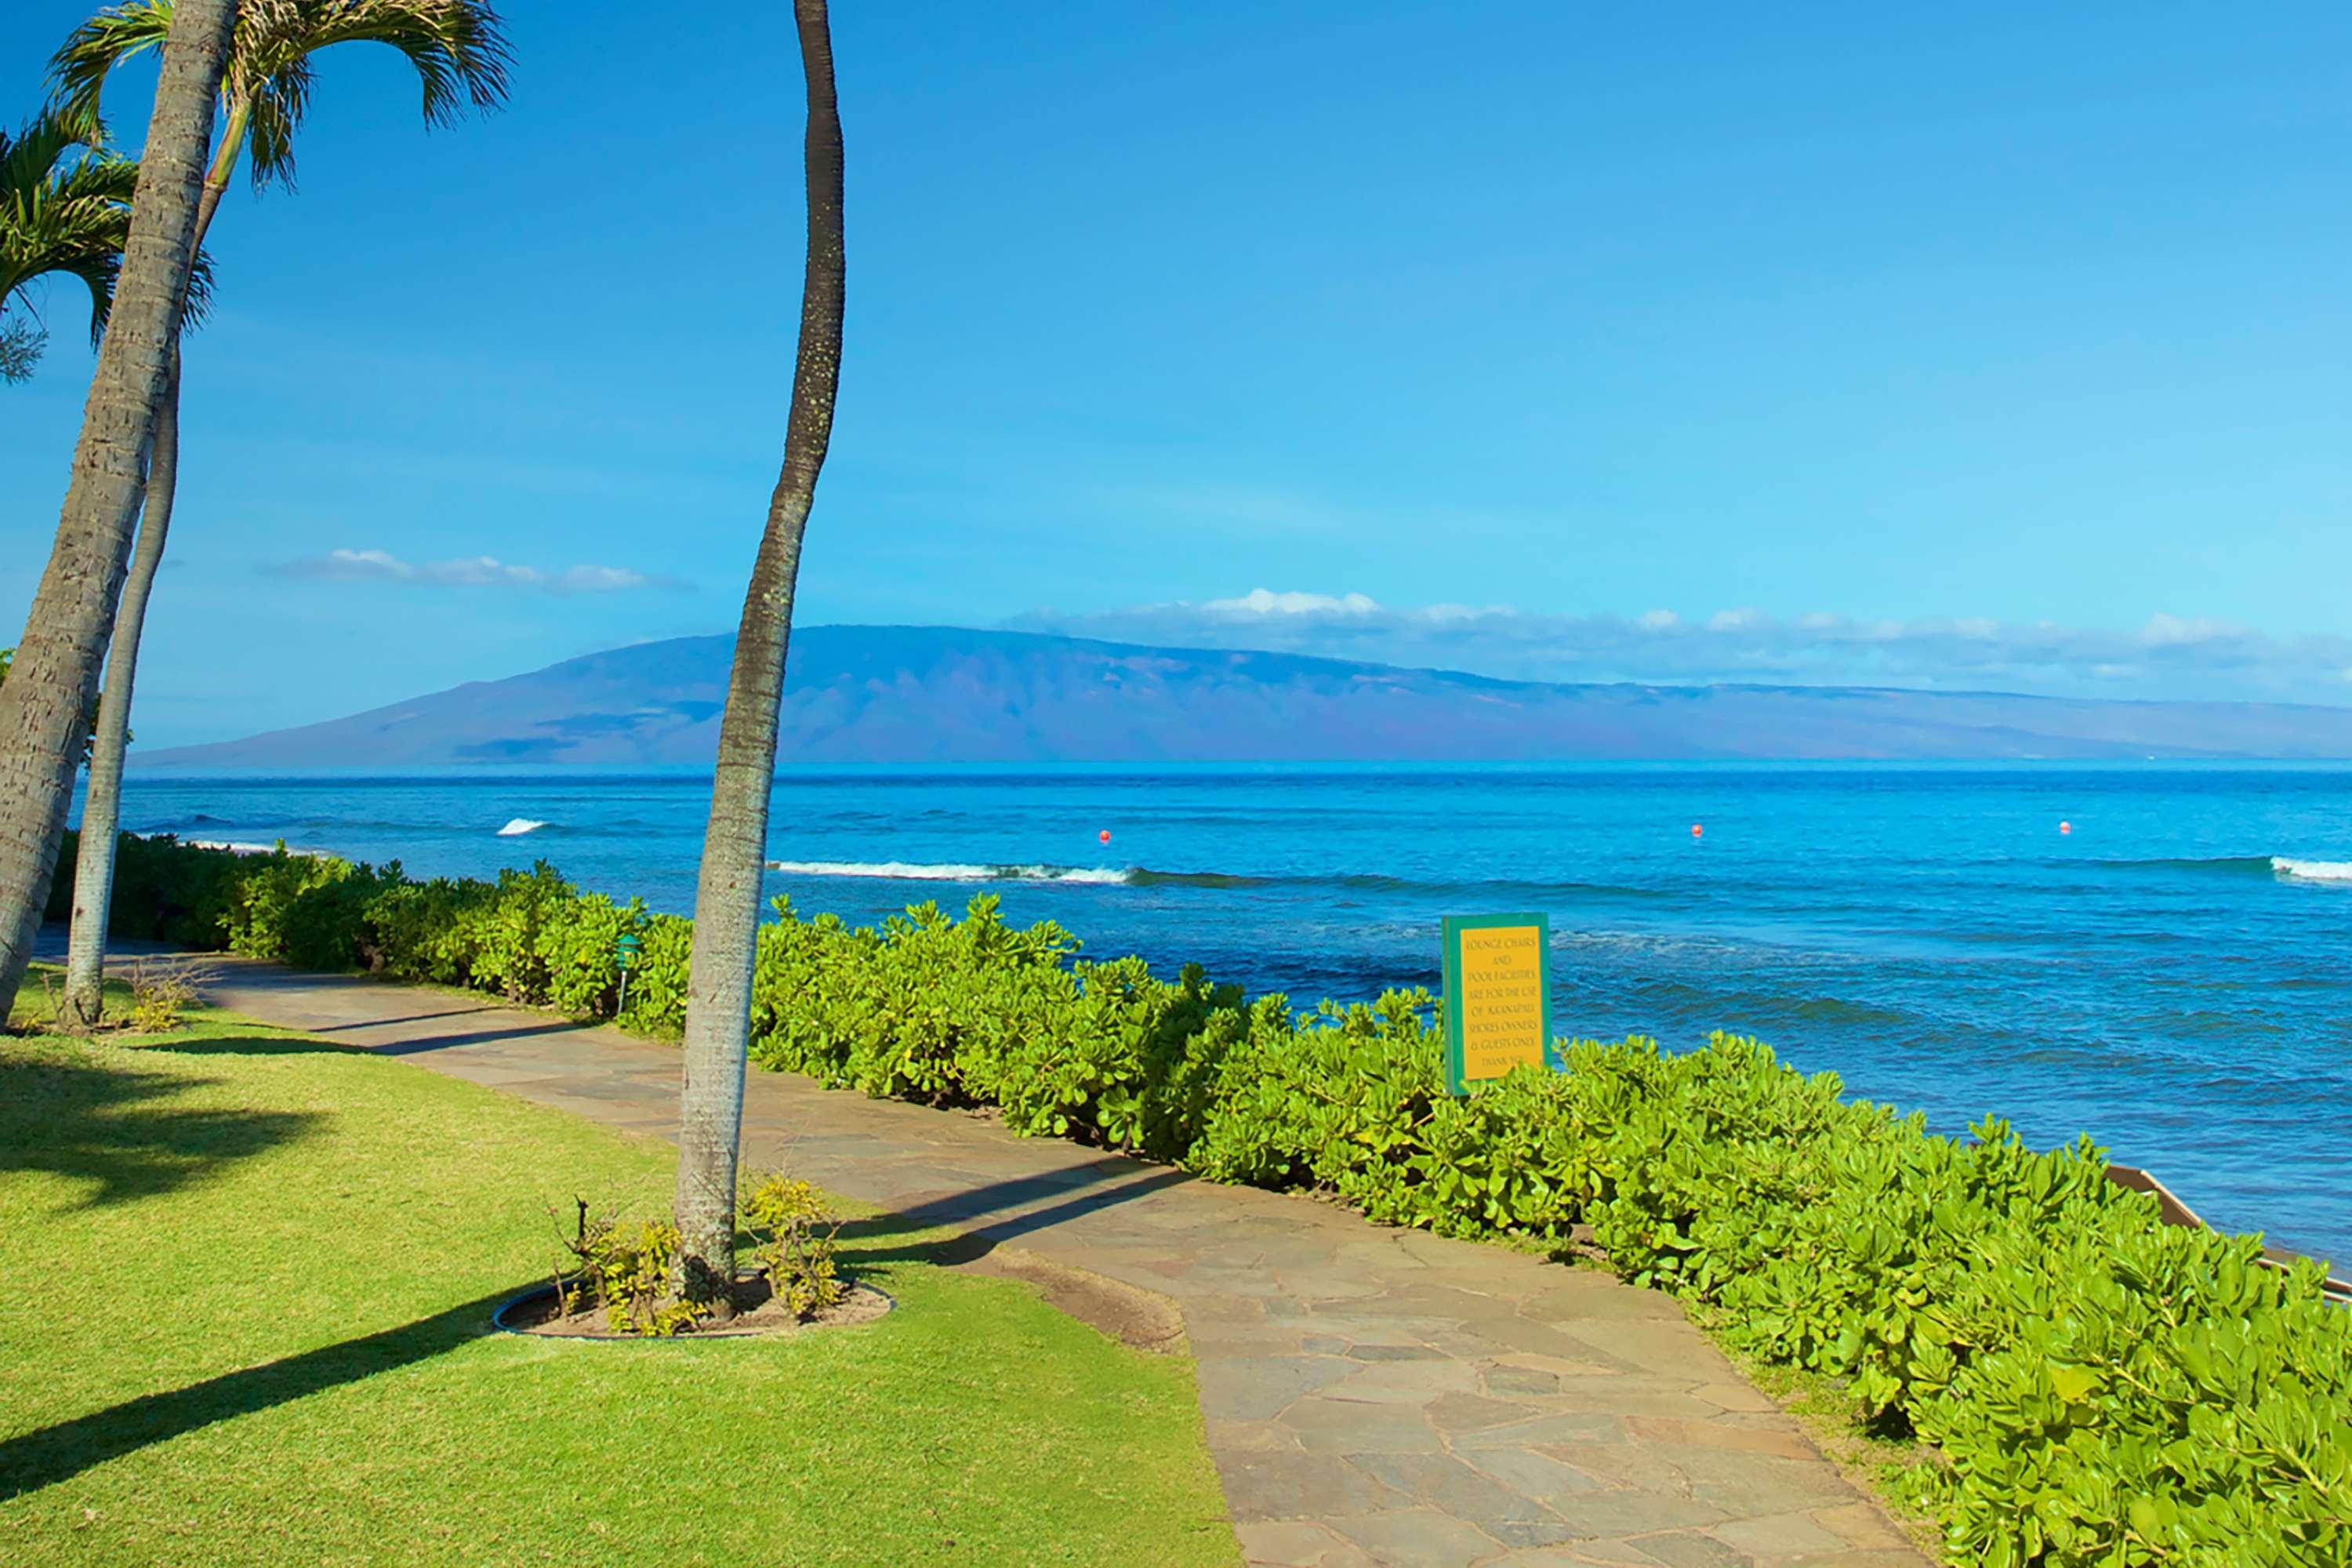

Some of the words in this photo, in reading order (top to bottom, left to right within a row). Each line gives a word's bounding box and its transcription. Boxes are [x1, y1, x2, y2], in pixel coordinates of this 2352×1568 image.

[1504, 937, 1536, 949] CHAIRS
[1493, 955, 1512, 965] AND
[1486, 987, 1504, 999] FOR
[1505, 986, 1519, 996] THE
[1471, 1006, 1483, 1017] OF
[1512, 1036, 1535, 1047] ONLY
